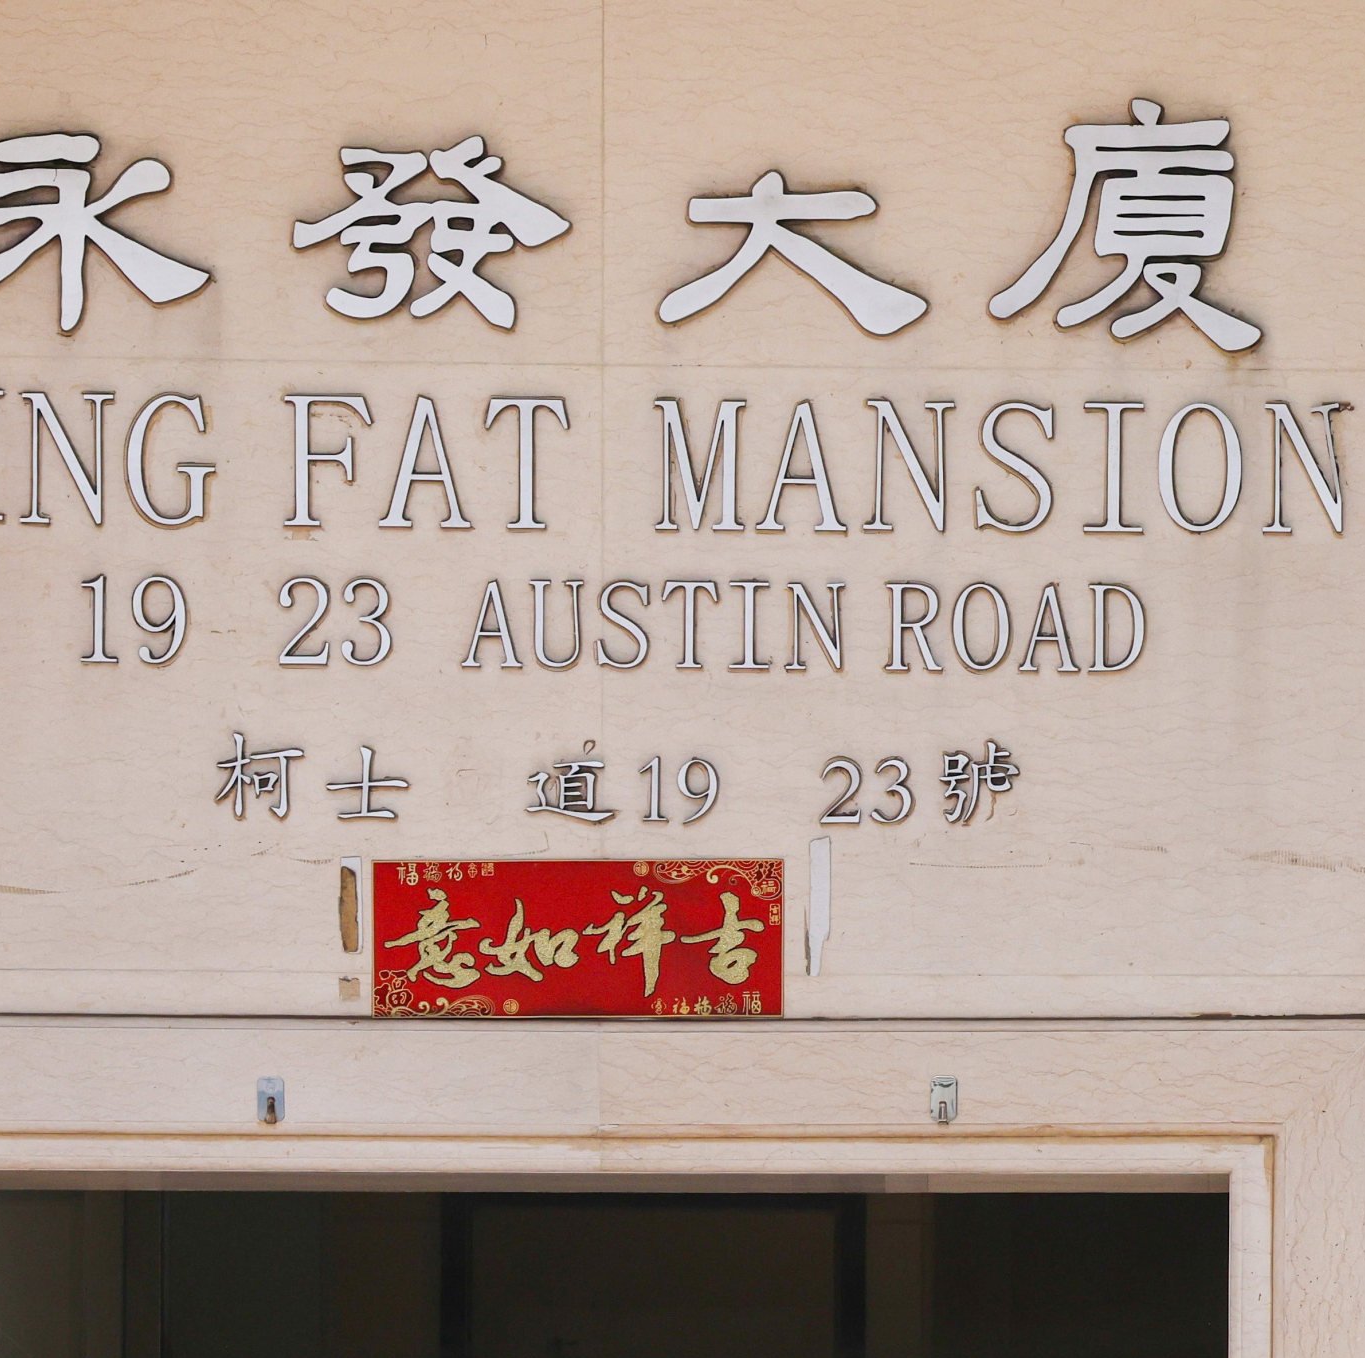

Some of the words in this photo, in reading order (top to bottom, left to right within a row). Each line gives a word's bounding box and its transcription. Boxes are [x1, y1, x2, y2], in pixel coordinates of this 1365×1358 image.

[285, 392, 573, 531] FAT
[653, 396, 1355, 536] MANSION
[78, 573, 190, 667] 19
[277, 573, 394, 668] 23
[460, 578, 845, 673] AUSTIN
[883, 578, 1148, 675] ROAD
